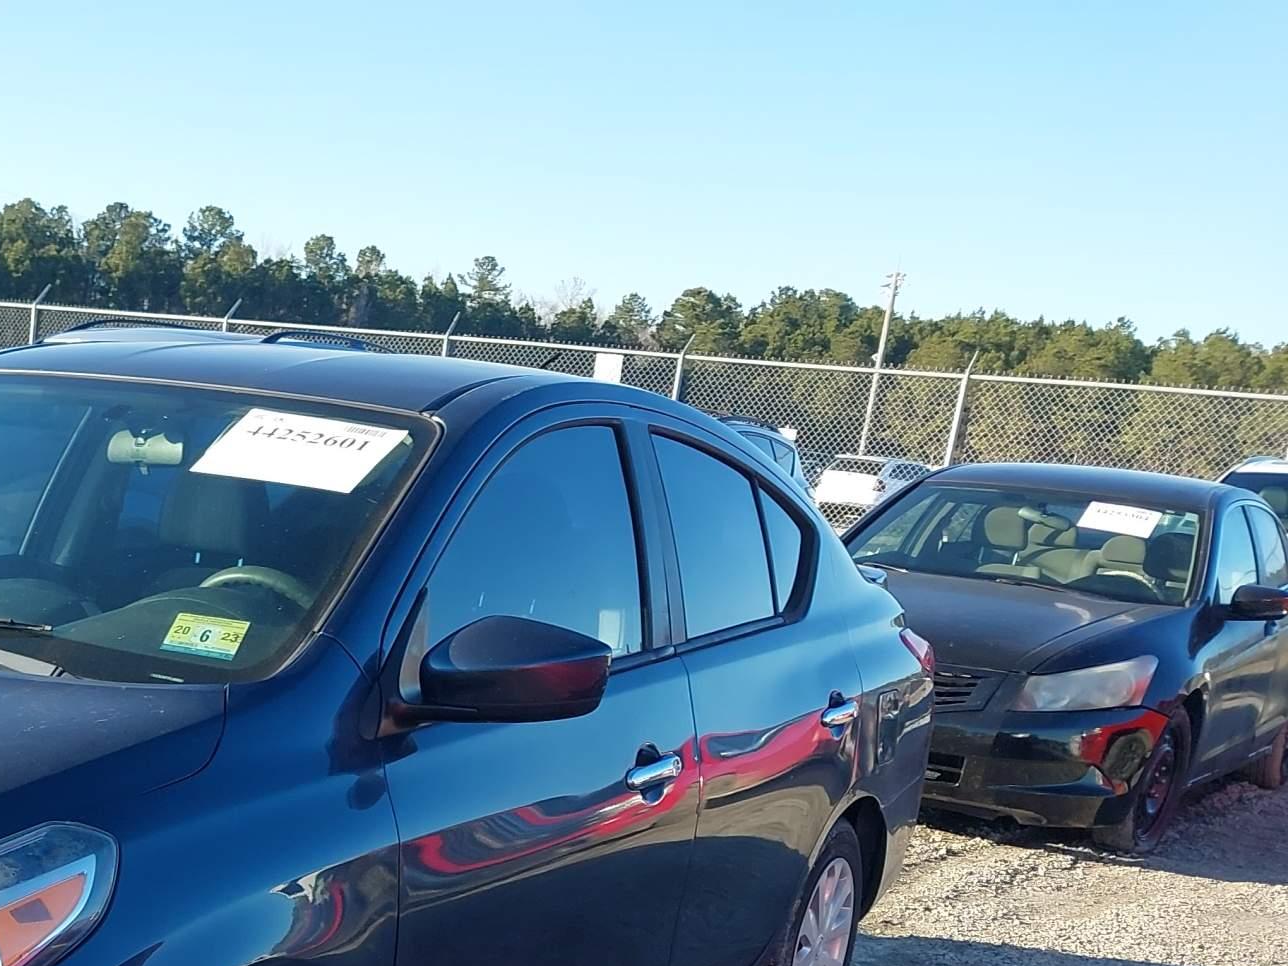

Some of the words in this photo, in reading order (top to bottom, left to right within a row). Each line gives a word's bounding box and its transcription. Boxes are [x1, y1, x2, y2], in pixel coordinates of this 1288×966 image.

[247, 425, 371, 451] 44252601
[174, 625, 191, 635] 20
[199, 629, 212, 643] 6
[220, 632, 240, 643] 23
